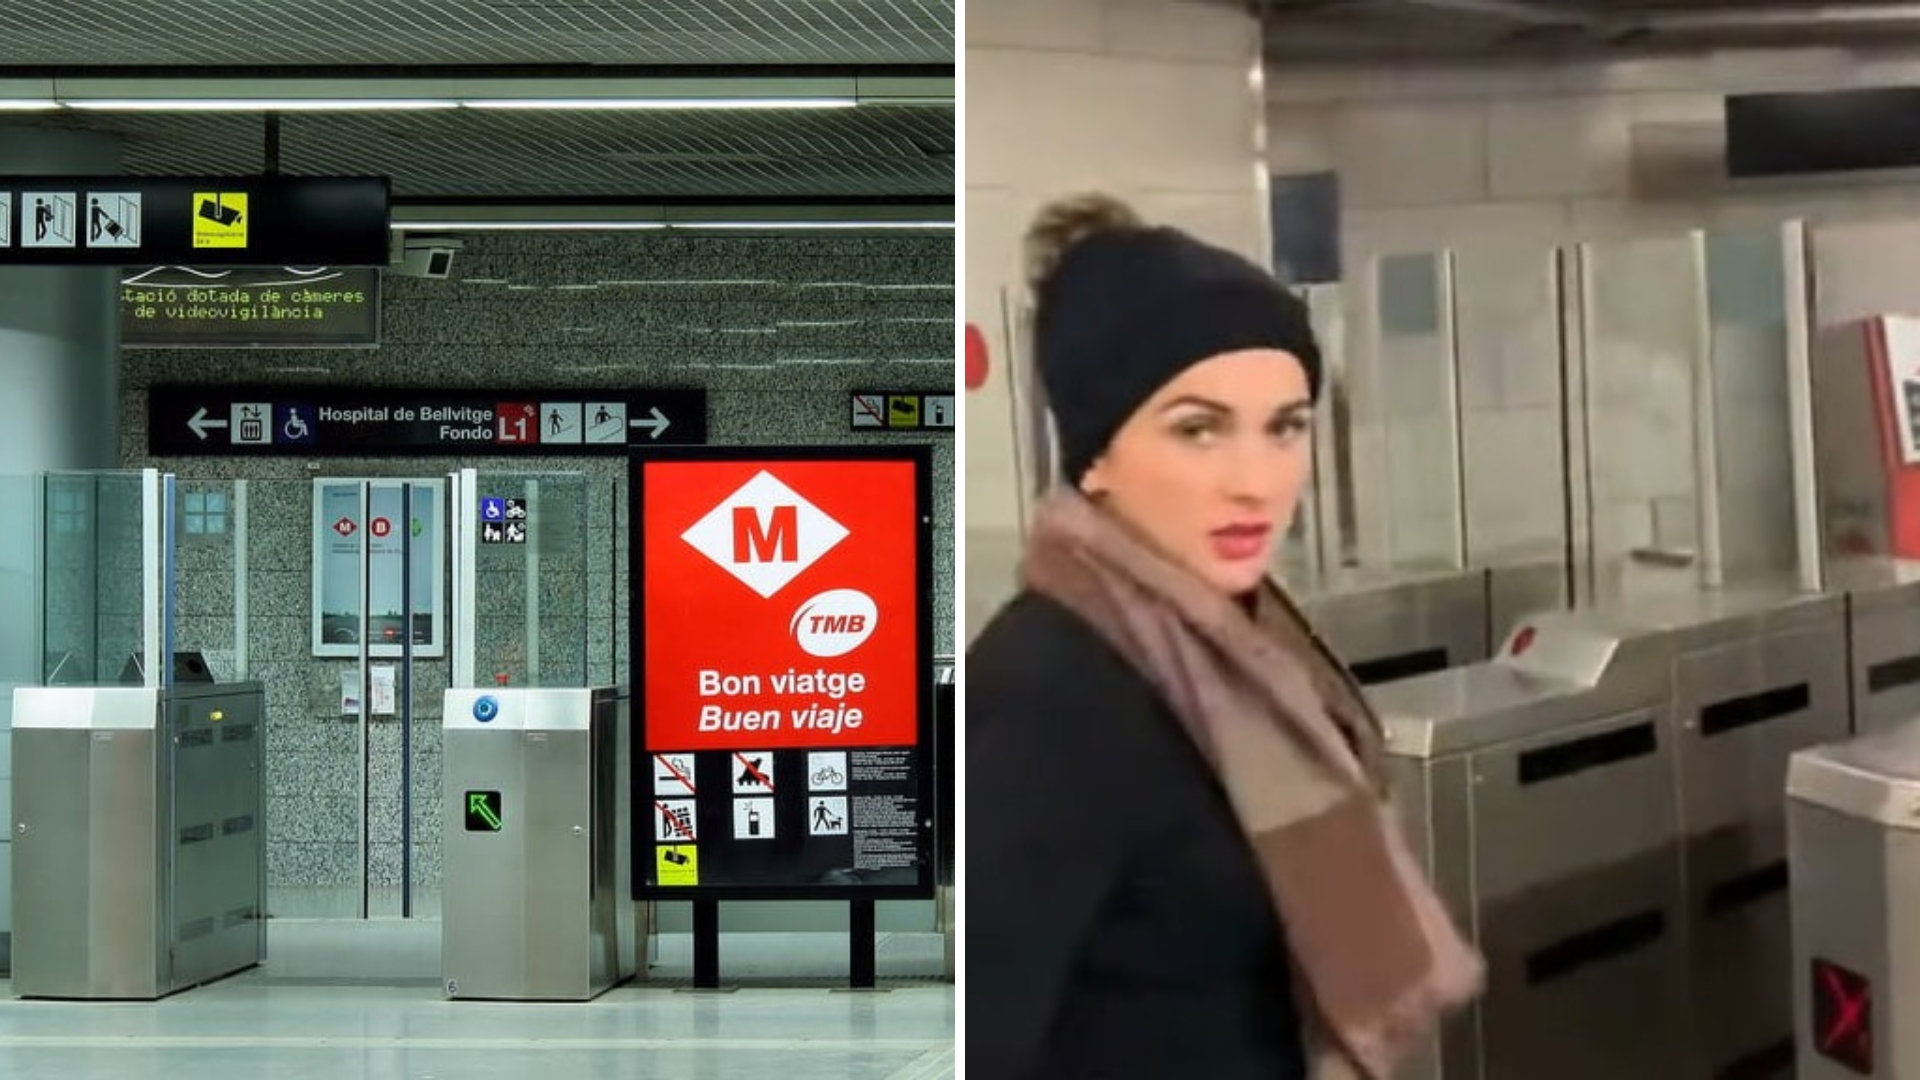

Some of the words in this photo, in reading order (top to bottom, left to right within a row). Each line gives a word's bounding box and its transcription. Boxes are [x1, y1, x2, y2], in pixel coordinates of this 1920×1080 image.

[121, 289, 178, 303] tació
[187, 288, 250, 303] dotada
[260, 288, 281, 303] de
[291, 288, 364, 303] càmeres
[134, 304, 156, 318] de
[165, 304, 323, 321] videovigilància
[318, 406, 389, 424] Hospital
[393, 406, 415, 421] de
[419, 406, 493, 424] Bellvitge
[499, 416, 527, 440] L1
[439, 425, 493, 440] Fondo
[732, 505, 798, 564] M
[809, 614, 866, 634] TMB
[699, 670, 761, 696] Bon
[770, 668, 866, 698] viatge
[698, 705, 781, 732] Buen
[790, 703, 863, 734] viaje
